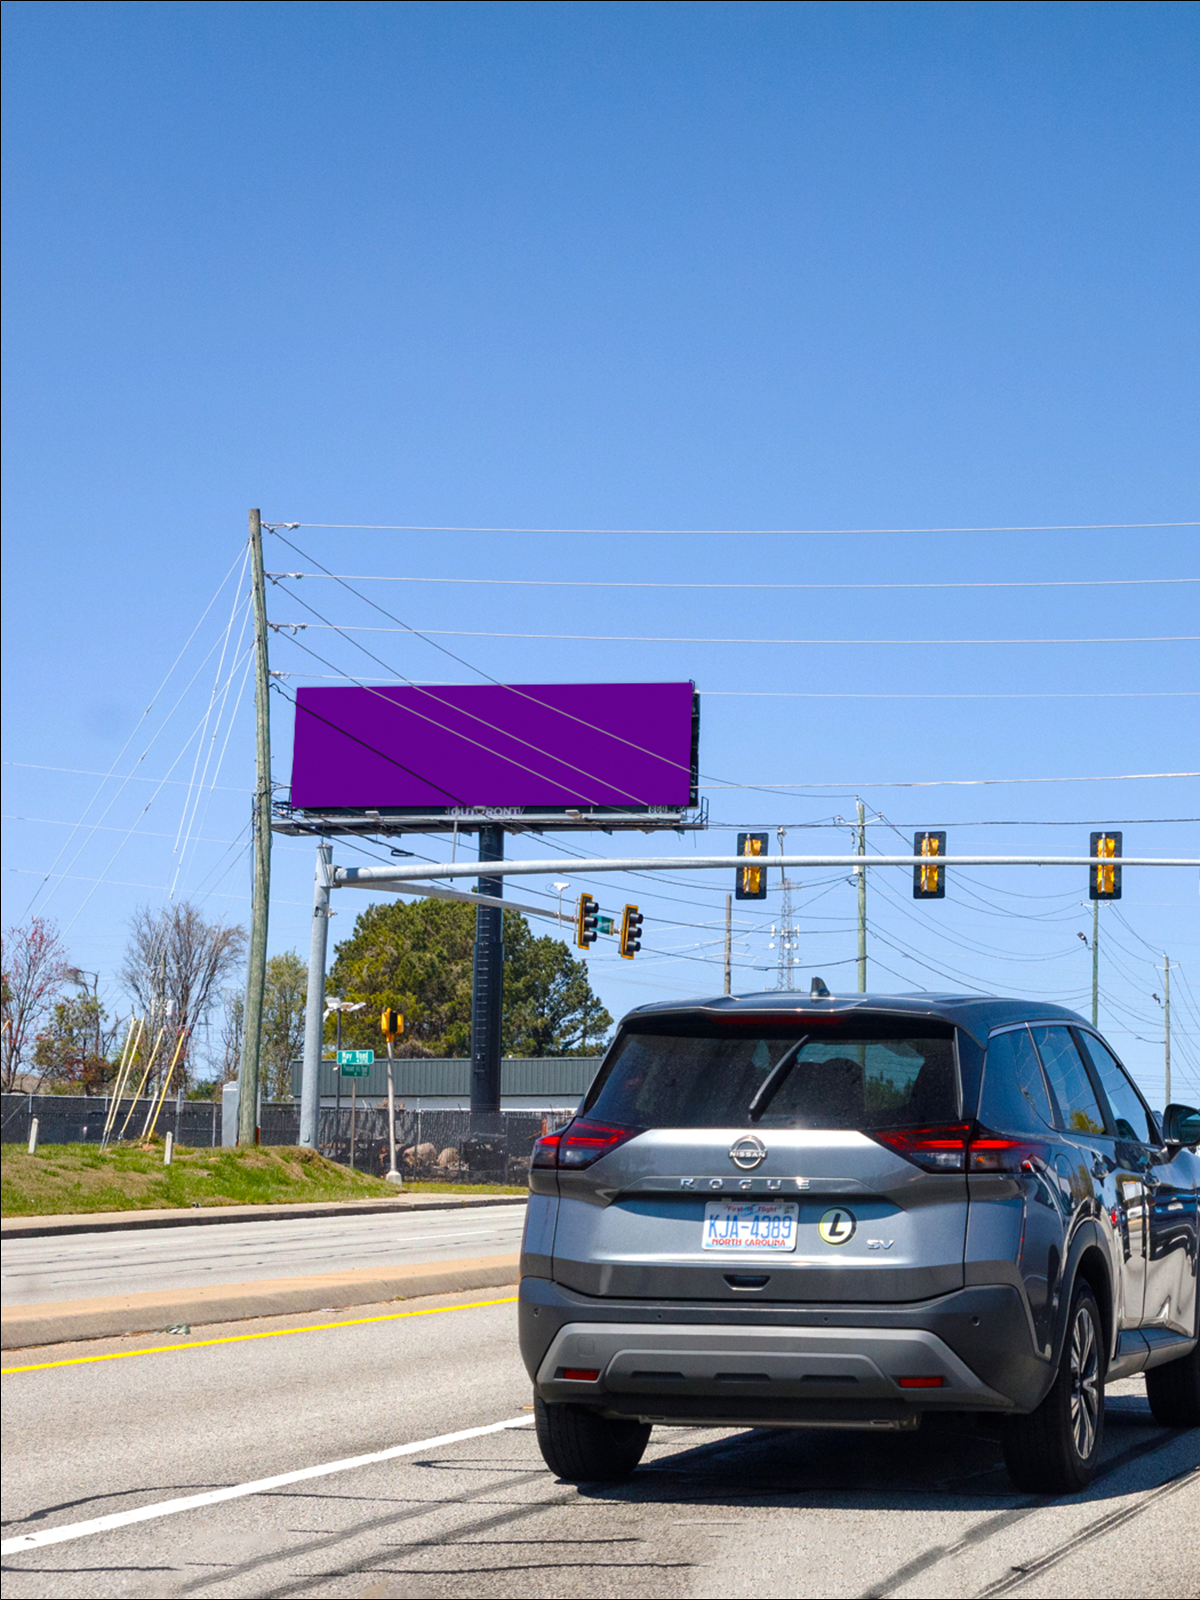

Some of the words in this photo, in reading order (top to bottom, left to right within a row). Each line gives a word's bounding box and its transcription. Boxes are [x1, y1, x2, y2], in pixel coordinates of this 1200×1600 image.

[451, 807, 520, 815] OUTRONT
[680, 1178, 810, 1190] ROGUE
[708, 1215, 793, 1239] KJA-4389
[712, 1238, 742, 1246] NORTH
[866, 1239, 895, 1250] SV
